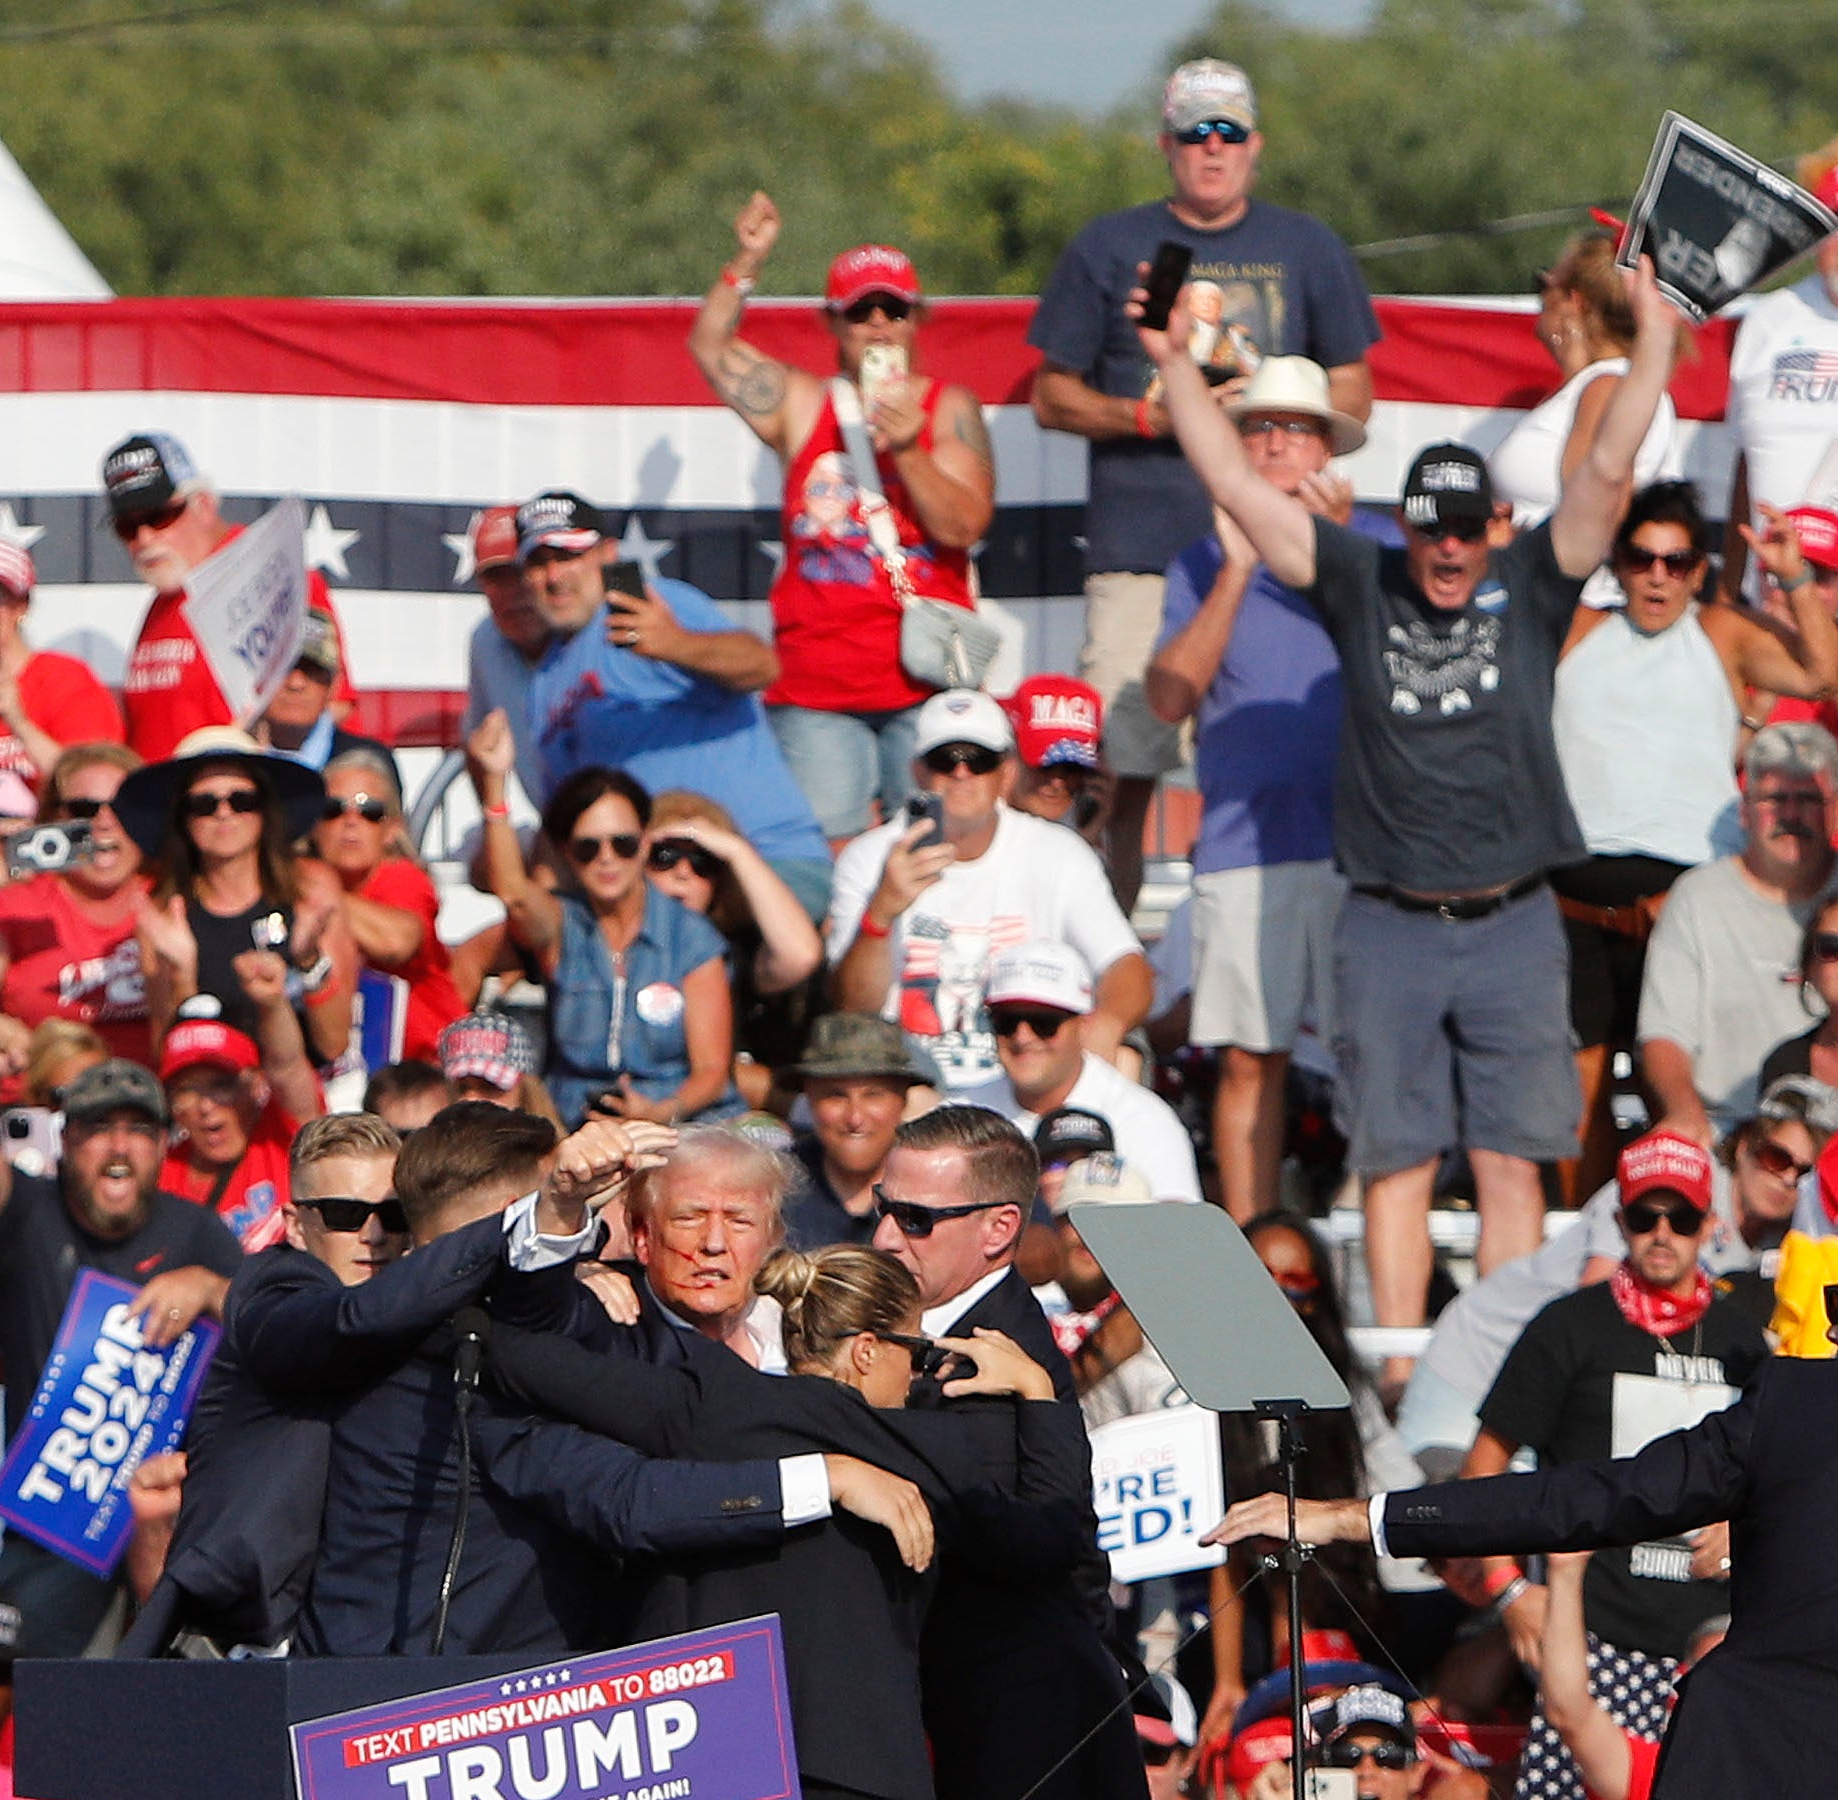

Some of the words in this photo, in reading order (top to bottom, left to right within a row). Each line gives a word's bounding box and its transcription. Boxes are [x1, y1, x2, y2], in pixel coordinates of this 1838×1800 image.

[1191, 262, 1236, 279] MAGA
[1240, 261, 1282, 279] KING
[1031, 694, 1098, 722] MAGA
[17, 1303, 150, 1508] TRUMP
[67, 1346, 165, 1505] 2024
[351, 1727, 416, 1765] TEXT
[419, 1682, 607, 1748] PENNSYLVANIA
[609, 1673, 645, 1702] TO
[647, 1656, 725, 1693] 88022
